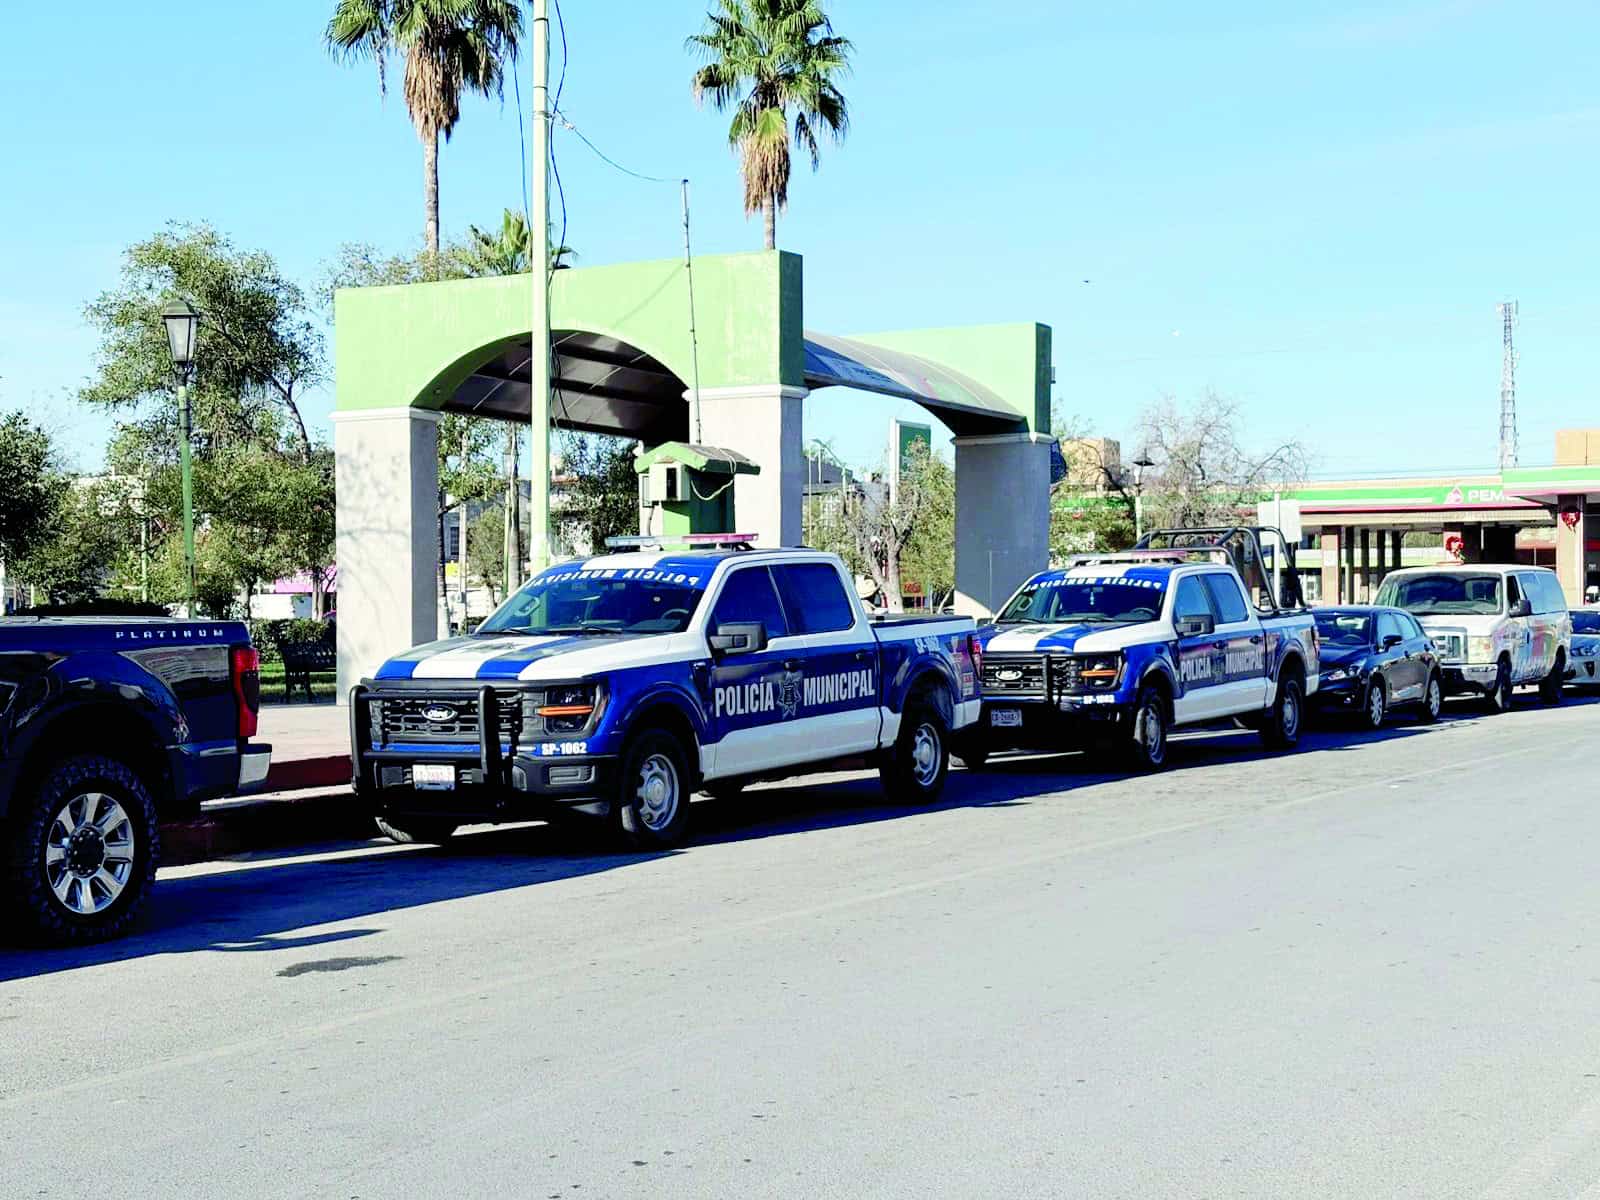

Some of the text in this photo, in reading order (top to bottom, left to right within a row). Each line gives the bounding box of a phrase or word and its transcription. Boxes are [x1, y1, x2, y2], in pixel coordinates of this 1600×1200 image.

[115, 629, 224, 639] PLATINUM
[1225, 650, 1264, 674] MUNICIPAL
[714, 669, 876, 718] POLICÍA MUNICIPAL
[541, 741, 588, 755] SP-1062
